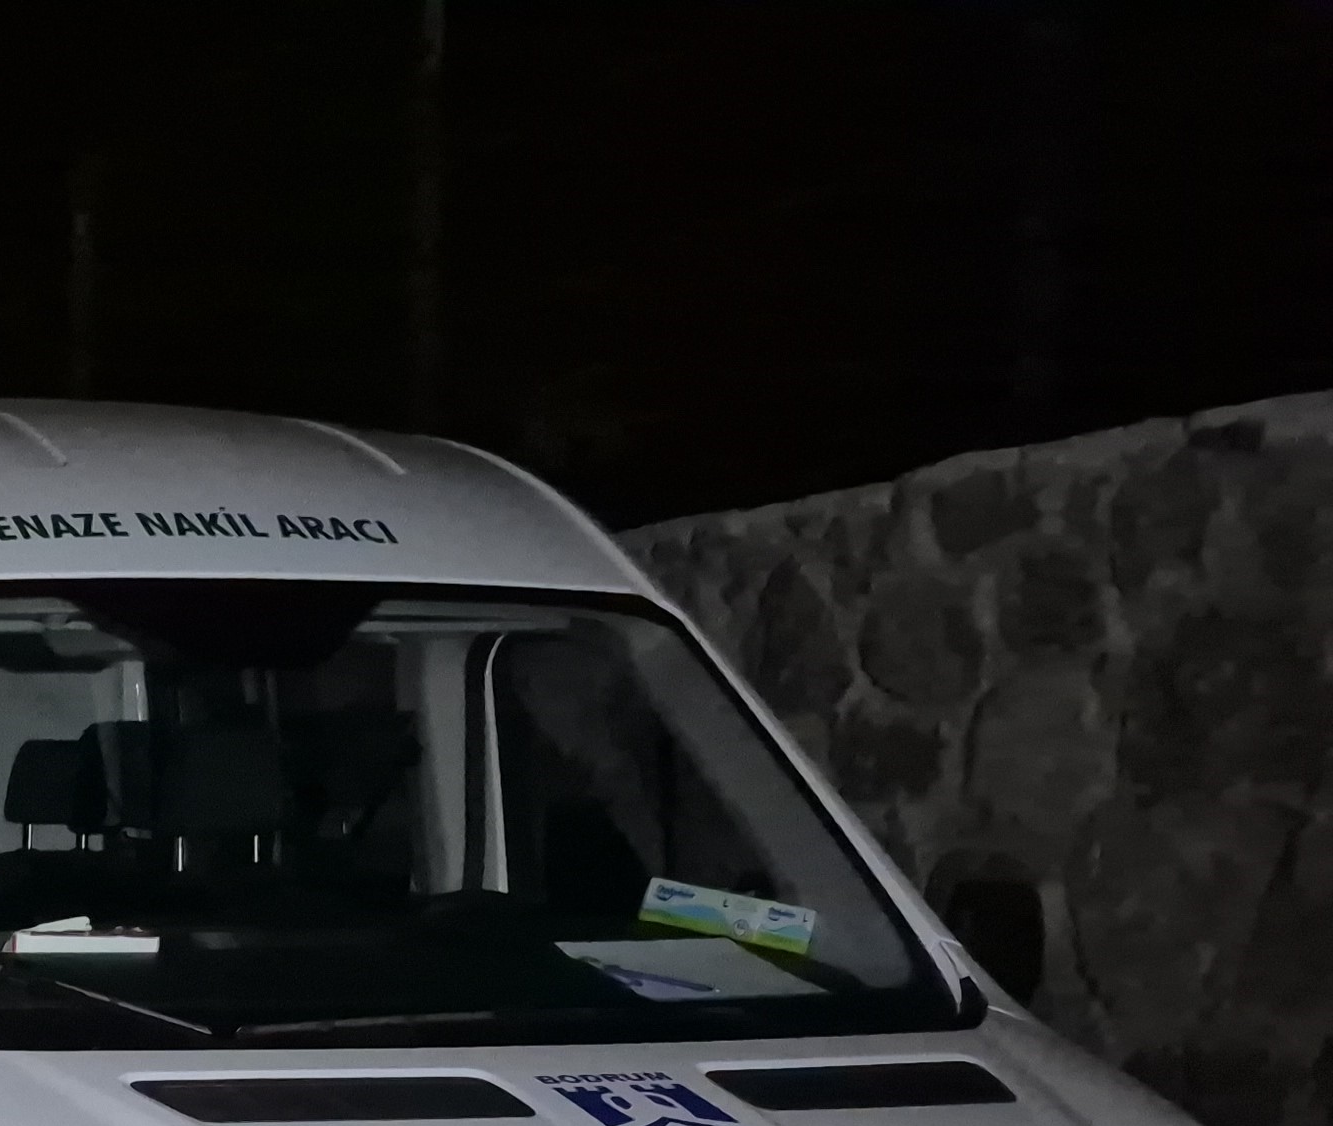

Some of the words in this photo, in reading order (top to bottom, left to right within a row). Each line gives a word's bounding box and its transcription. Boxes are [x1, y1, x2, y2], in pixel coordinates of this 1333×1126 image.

[134, 506, 270, 539] NAKİL
[276, 513, 400, 544] ARACI
[535, 1072, 673, 1085] BODRUM
